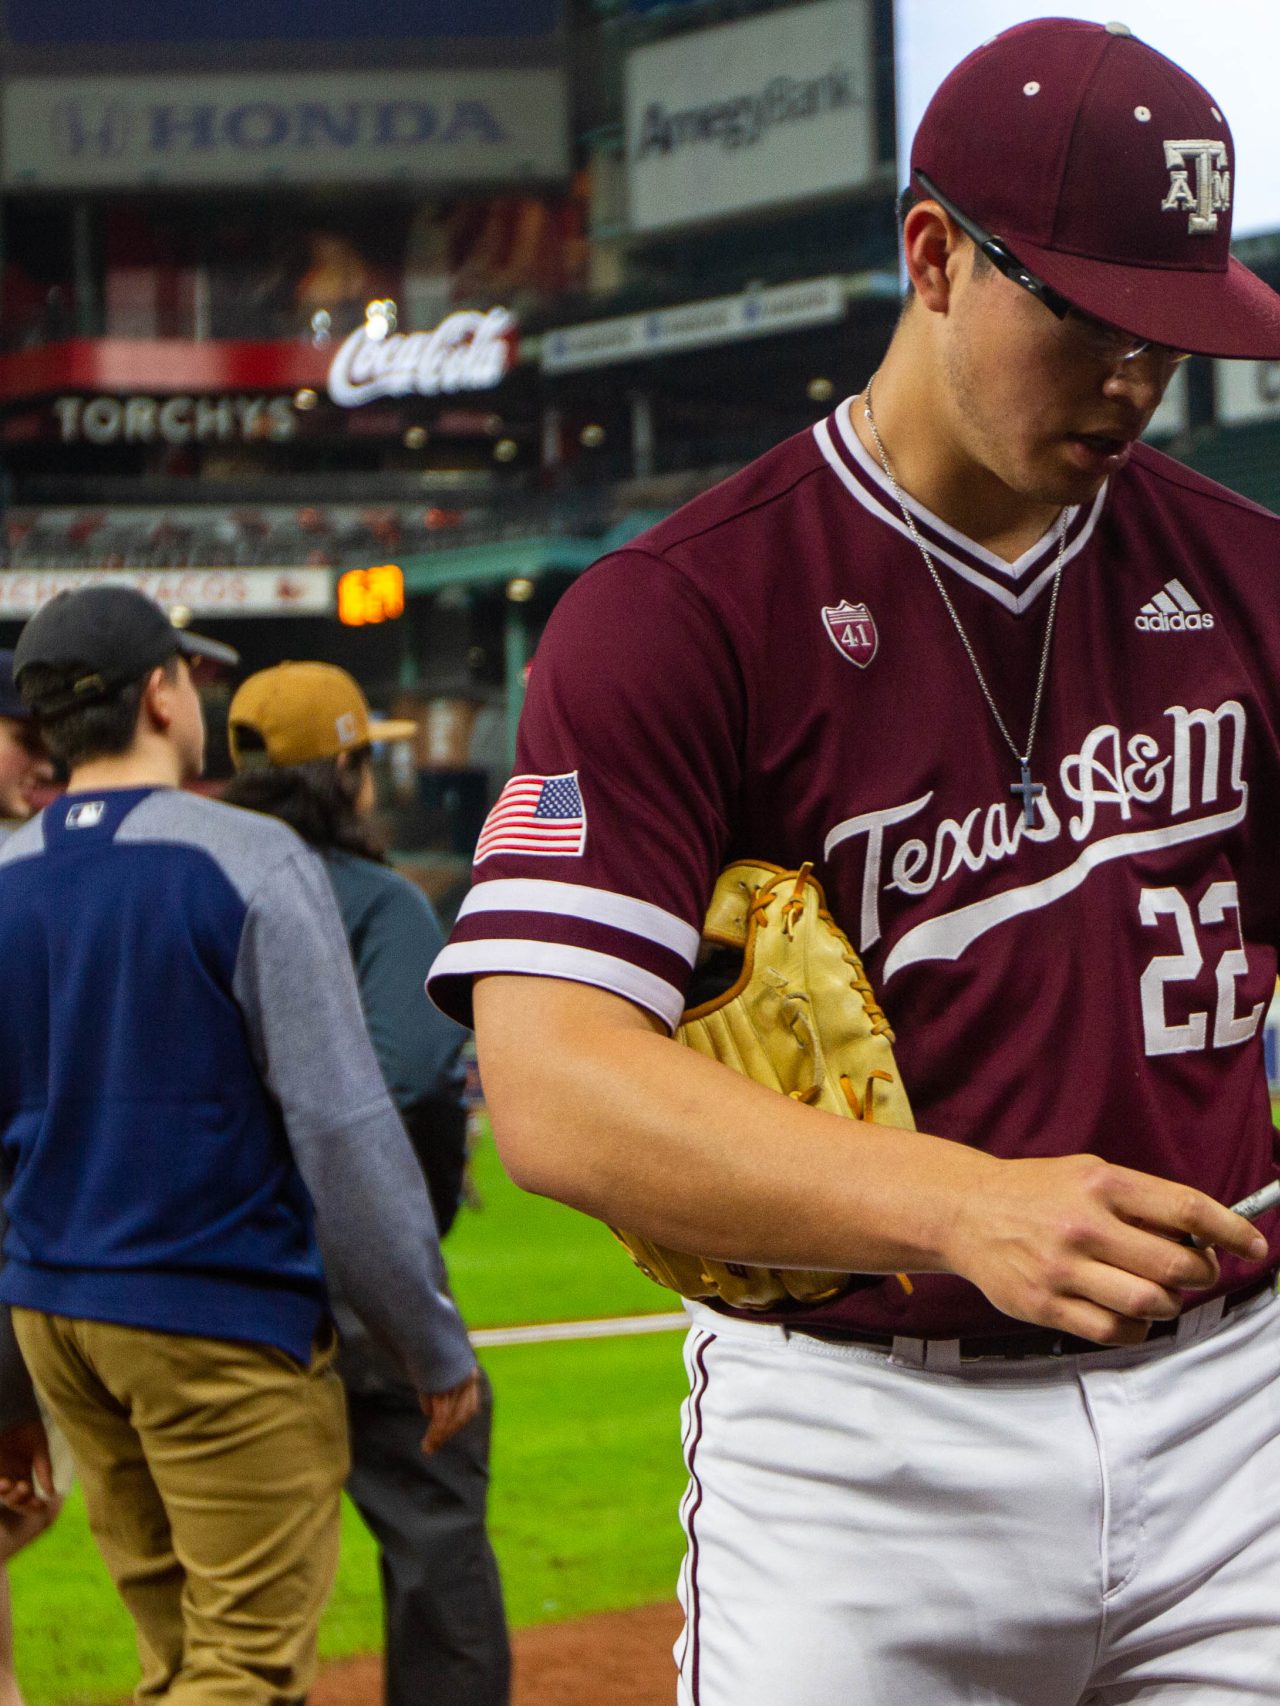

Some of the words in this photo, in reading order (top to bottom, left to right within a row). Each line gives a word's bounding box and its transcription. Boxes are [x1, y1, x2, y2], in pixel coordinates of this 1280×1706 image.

[152, 99, 506, 149] HONDA
[841, 623, 872, 647] 41
[1135, 611, 1214, 631] adidas
[824, 790, 1061, 953] Texas
[1060, 700, 1248, 842] A&M
[1138, 880, 1266, 1057] 22
